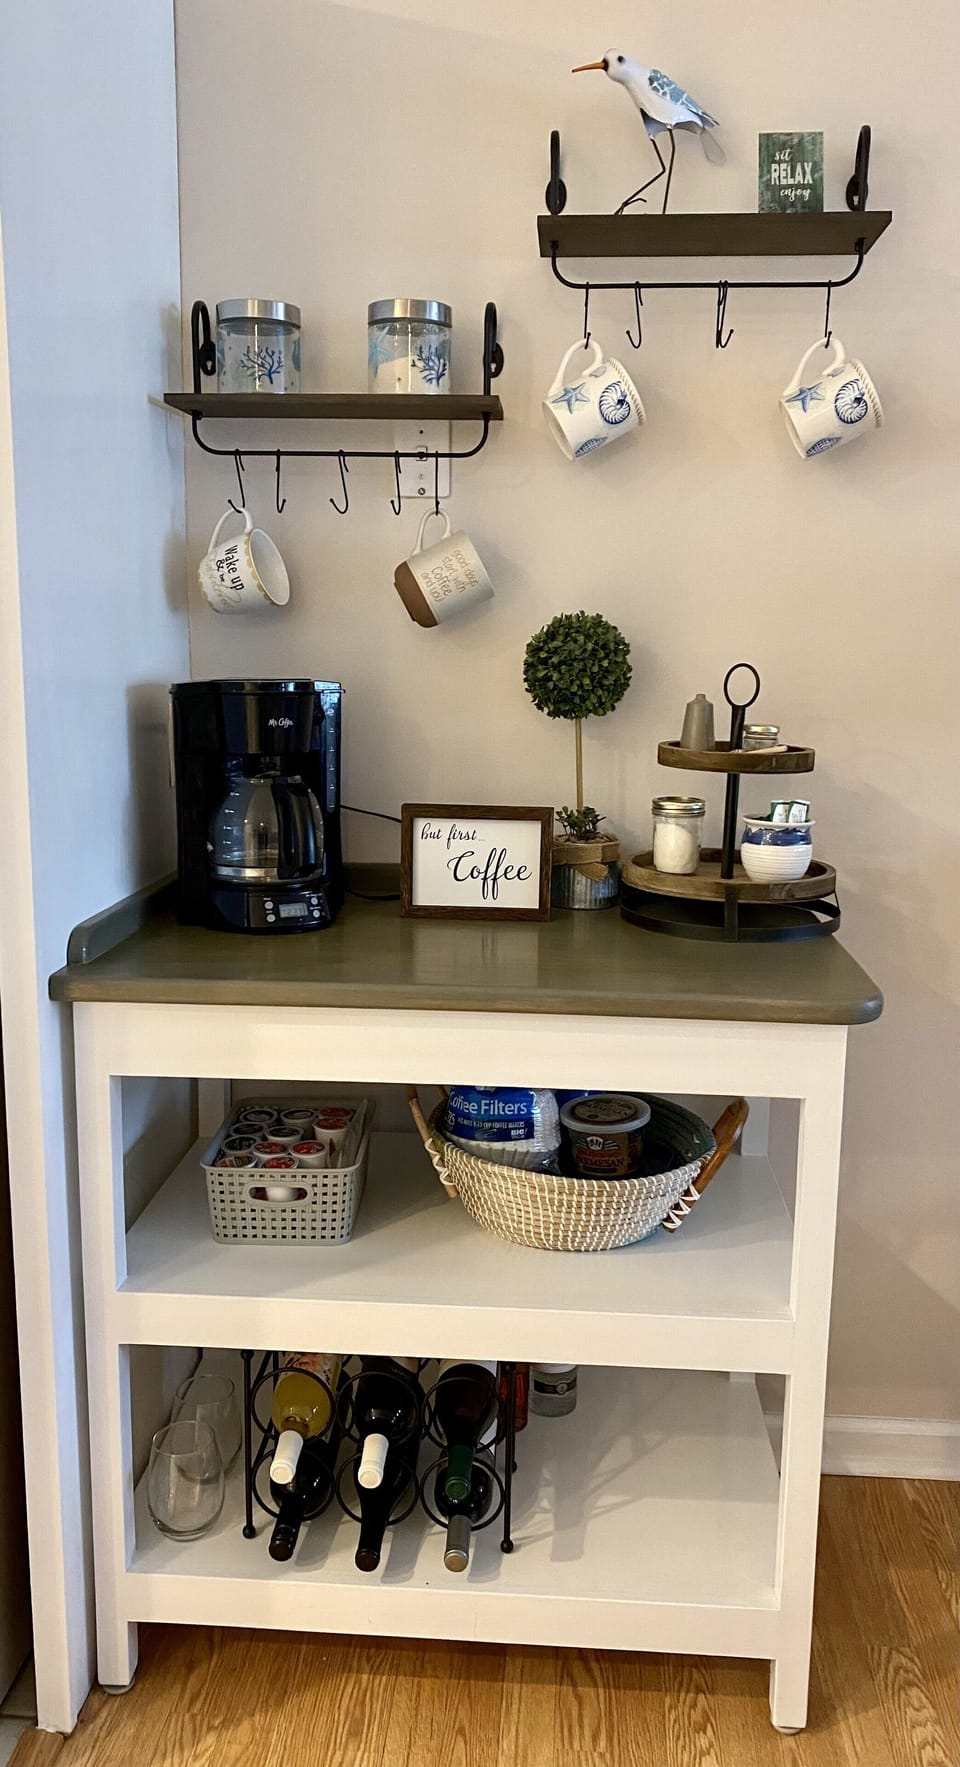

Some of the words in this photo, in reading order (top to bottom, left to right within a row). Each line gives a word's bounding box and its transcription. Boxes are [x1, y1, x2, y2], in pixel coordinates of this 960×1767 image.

[774, 148, 792, 161] sit
[771, 162, 813, 185] RELAX
[780, 187, 811, 201] enjoy
[224, 545, 239, 575] Wake
[451, 549, 471, 569] good
[230, 576, 245, 591] up
[432, 566, 453, 596] Coffee
[421, 822, 442, 840] but
[446, 847, 533, 901] Coffee
[449, 1090, 479, 1114] Coffee
[481, 1099, 527, 1115] Filters
